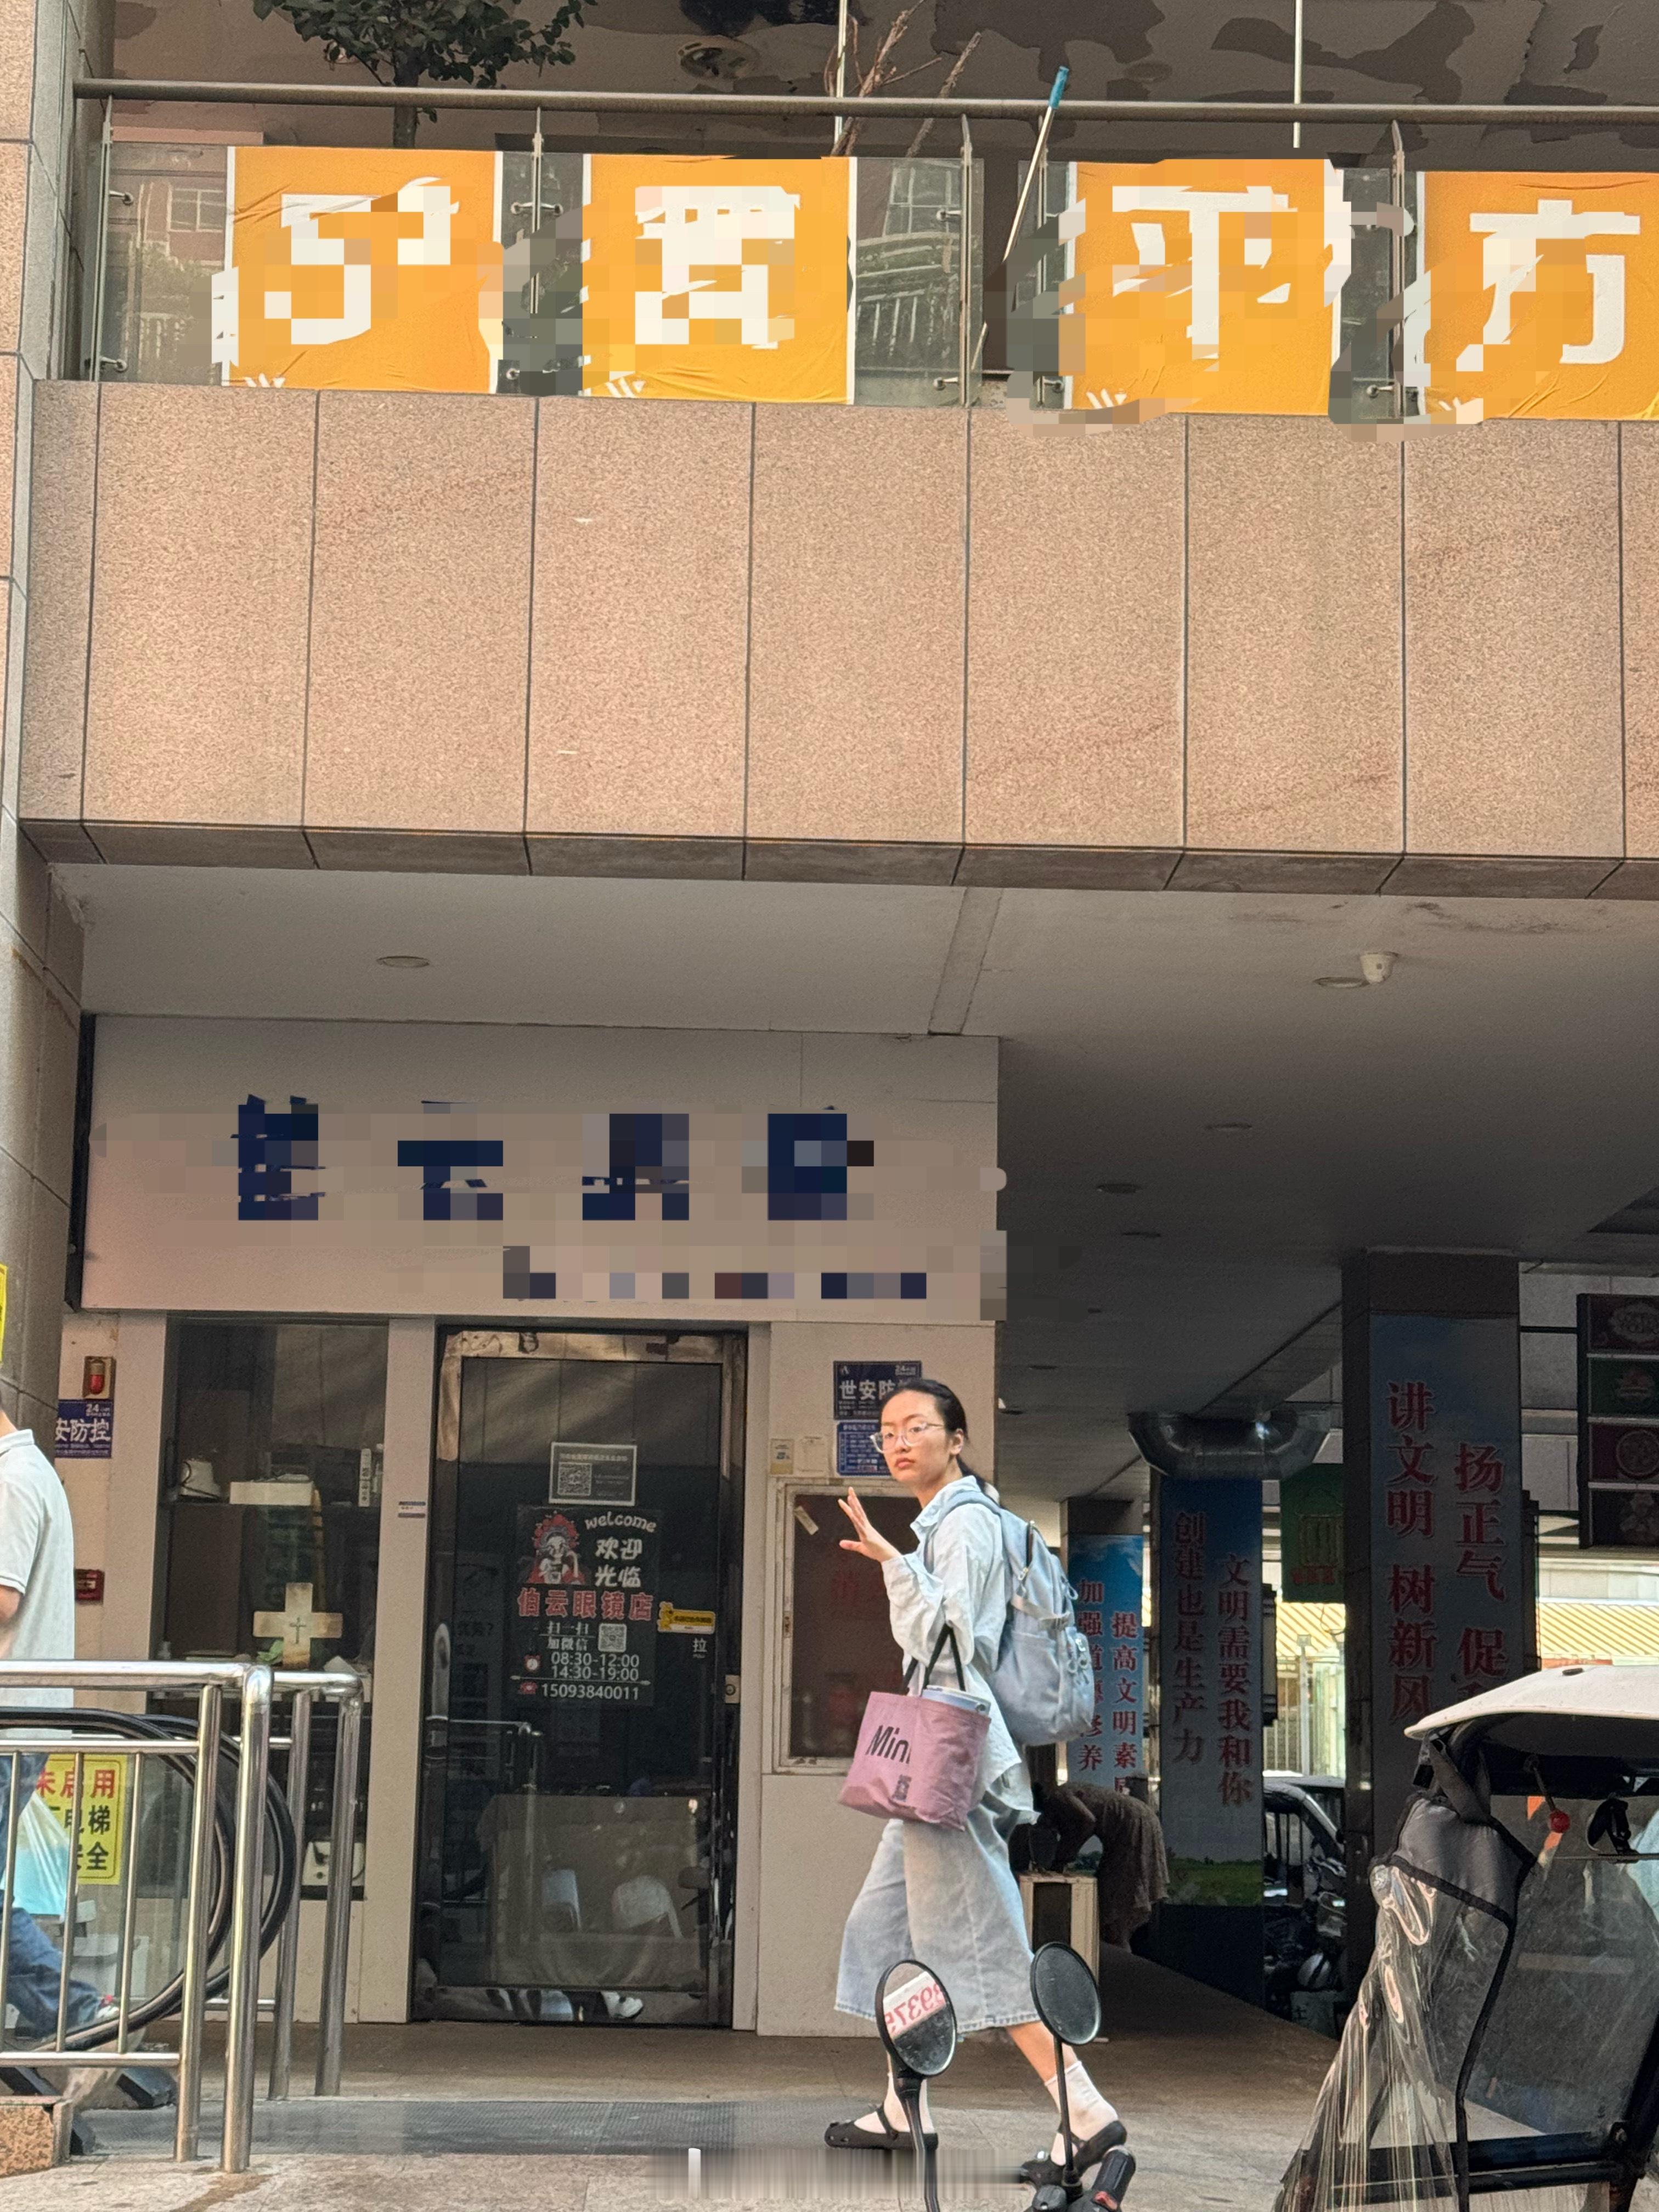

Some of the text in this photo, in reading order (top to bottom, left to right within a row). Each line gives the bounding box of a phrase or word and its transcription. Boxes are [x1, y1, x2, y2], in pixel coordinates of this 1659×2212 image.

[839, 1379, 910, 1401] 世安防
[584, 1511, 657, 1533] welcome
[1454, 1441, 1506, 1603] 扬正气
[595, 1536, 642, 1560] 欢迎
[1385, 1380, 1436, 1719] 讲文明 树新风
[594, 1564, 641, 1588] 光临
[692, 1638, 708, 1653] 拉
[1173, 1512, 1206, 1765] 创建也是生产力
[551, 1651, 639, 1667] 08:30-12:00
[551, 1666, 639, 1681] 14:30-19:00
[1218, 1554, 1251, 1805] 文明需要我和你
[542, 1683, 639, 1700] 15093840011
